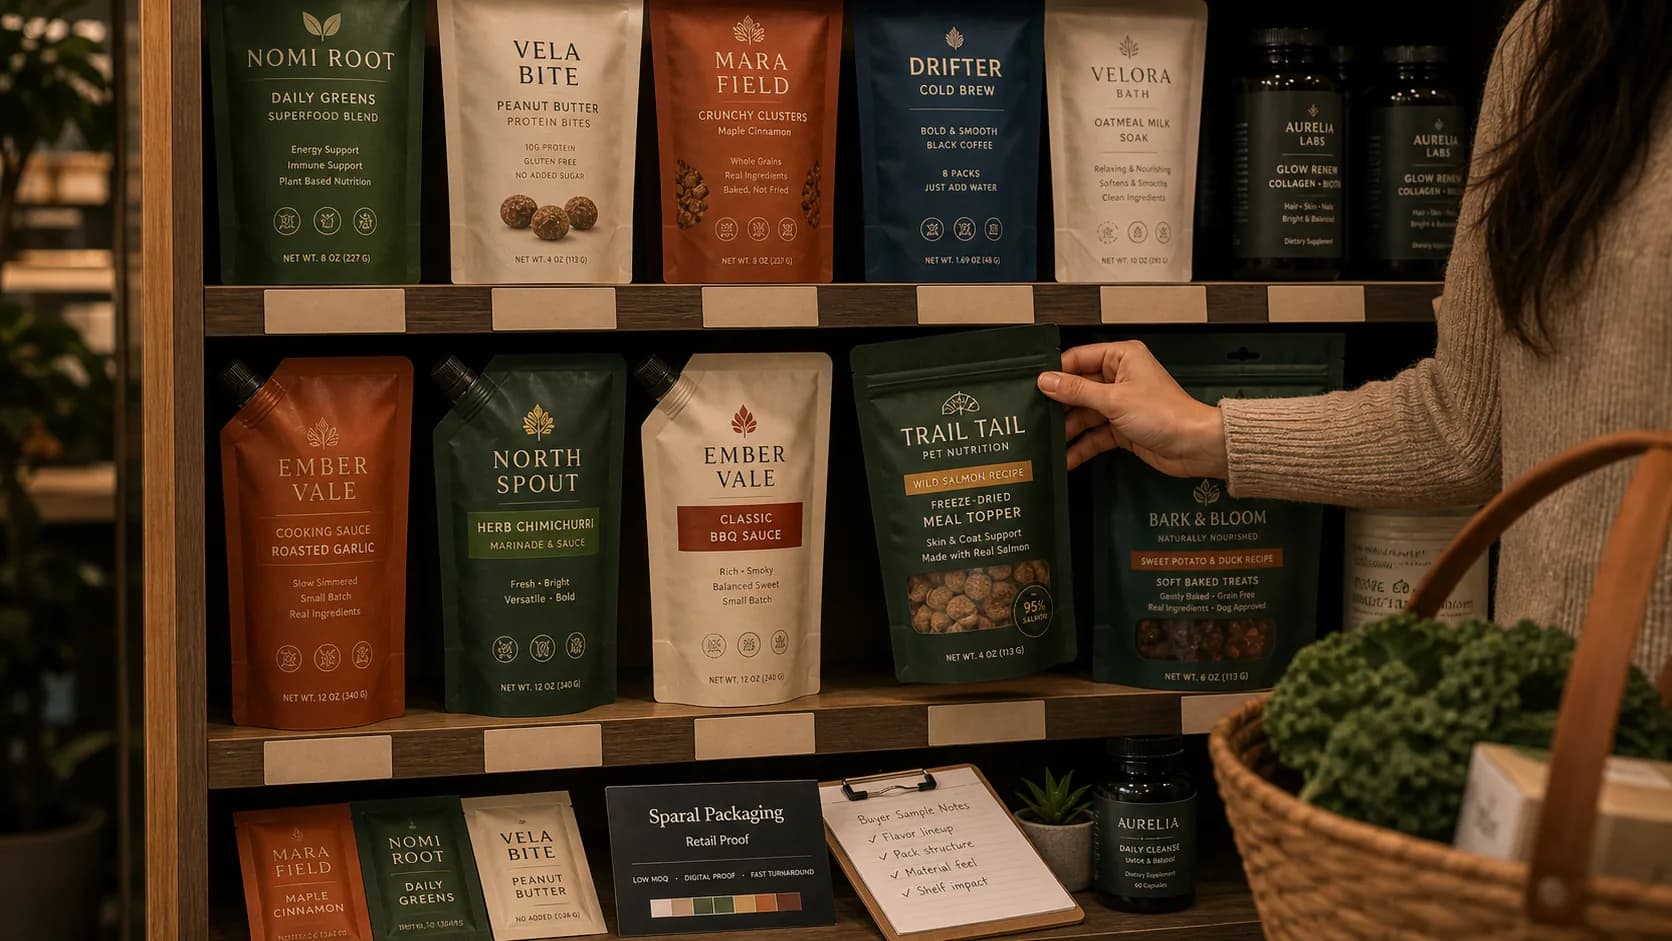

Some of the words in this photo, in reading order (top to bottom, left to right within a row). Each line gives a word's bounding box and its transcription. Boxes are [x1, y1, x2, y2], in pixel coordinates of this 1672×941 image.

[513, 40, 581, 61] VELA
[247, 48, 316, 68] NOMI
[329, 49, 395, 70] ROOT
[715, 51, 788, 70] MARA
[909, 57, 1002, 77] DRIFTER
[520, 65, 579, 86] BITE
[1091, 66, 1171, 84] VELORA
[717, 76, 789, 94] FIELD
[920, 85, 954, 95] COLD
[960, 85, 995, 96] BREW
[271, 92, 314, 104] DAILY
[320, 93, 376, 105] GREENS
[1117, 89, 1150, 99] BATH
[497, 101, 548, 112] PEANUT
[553, 102, 599, 114] BUTTER
[268, 111, 339, 121] SUPERFOOD
[344, 112, 378, 122] BLEND
[507, 117, 557, 127] PROTEIN
[562, 118, 591, 128] BITES
[699, 111, 753, 120] CRUNCHY
[758, 111, 808, 122] CLUSTERS
[1095, 118, 1144, 127] OATMEAL
[1148, 118, 1170, 128] MILK
[718, 127, 745, 137] Maple
[748, 127, 791, 136] Cinnamon
[921, 127, 946, 135] BOLD
[959, 127, 998, 135] SMOOTH
[1285, 122, 1334, 133] AURELIA
[1120, 133, 1148, 143] SOAK
[1300, 137, 1325, 146] LABS
[291, 145, 323, 156] Energy
[325, 145, 359, 156] Support
[927, 141, 957, 149] BLACK
[960, 141, 993, 149] COFFEE
[287, 161, 325, 170] Immune
[327, 161, 363, 172] Support
[558, 158, 576, 166] FREE
[1277, 165, 1308, 174] GLOW
[1311, 165, 1337, 174] RENEW
[279, 176, 302, 186] Plant
[305, 177, 331, 186] Based
[334, 177, 371, 186] Nutrition
[1269, 180, 1316, 188] COLLAGEN
[925, 184, 945, 192] JUST
[948, 184, 967, 192] ADD
[970, 184, 997, 192] WATER
[901, 422, 968, 447] TRAIL
[974, 416, 1026, 438] TAIL
[704, 446, 785, 465] EMBER
[922, 450, 942, 460] PET
[947, 442, 1009, 458] NUTRITION
[493, 448, 581, 469] NORTH
[279, 456, 368, 477] EMBER
[497, 473, 579, 494] SPOUT
[717, 470, 776, 488] VALE
[913, 478, 939, 488] WILD
[942, 472, 985, 485] SALMON
[989, 468, 1024, 480] RECIPE
[292, 482, 357, 502] VALE
[931, 492, 1011, 510] FREEZE-DRIED
[720, 513, 773, 525] CLASSIC
[923, 515, 962, 528] MEAL
[967, 506, 1021, 524] TOPPER
[1150, 512, 1190, 527] BARK
[1195, 512, 1206, 526] &
[1211, 510, 1267, 526] BLOOM
[276, 526, 332, 538] COOKING
[336, 524, 371, 536] SAUCE
[477, 522, 512, 533] HERB
[516, 519, 594, 532] CHIMICHURRI
[710, 532, 737, 543] BBQ
[743, 529, 781, 541] SAUCE
[926, 537, 946, 547] Skin
[949, 536, 956, 545] &
[959, 533, 982, 544] Coat
[985, 529, 1022, 543] Support
[1158, 534, 1207, 543] NATURALLY
[1210, 533, 1258, 542] NOURISHED
[272, 545, 329, 557] ROASTED
[334, 542, 375, 555] GARLIC
[490, 540, 544, 550] MARINADE
[548, 540, 553, 549] &
[557, 538, 585, 548] SAUCE
[922, 553, 947, 562] Made
[950, 550, 970, 559] with
[974, 547, 994, 557] Real
[997, 542, 1030, 555] Salmon
[1141, 557, 1168, 565] SWEET
[1172, 556, 1207, 565] POTATO
[1219, 556, 1243, 564] DUCK
[1246, 555, 1273, 563] RECIPE
[720, 567, 738, 576] Rich
[747, 566, 773, 576] Smoky
[293, 578, 314, 587] Slow
[316, 576, 358, 587] Simmered
[511, 579, 535, 589] Fresh
[544, 578, 570, 588] Bright
[713, 581, 753, 591] Balanced
[755, 581, 779, 590] Sweet
[1156, 578, 1181, 586] SOFT
[1185, 577, 1219, 586] BAKED
[1223, 576, 1259, 585] TREATS
[301, 593, 325, 603] Small
[328, 592, 352, 602] Batch
[504, 594, 545, 604] Versatile
[556, 593, 575, 602] Bold
[722, 596, 747, 606] Small
[749, 595, 773, 605] Batch
[1023, 599, 1046, 613] 95%
[290, 609, 309, 619] Real
[312, 607, 361, 620] Ingredients
[649, 807, 700, 828] Sparal
[704, 805, 784, 824] Packaging
[858, 814, 890, 826] Buyer
[896, 807, 935, 820] Sample
[938, 802, 970, 812] Notes
[1118, 817, 1179, 830] AURELIA
[500, 831, 552, 844] VELA
[686, 836, 717, 847] Retail
[720, 833, 750, 845] Proof
[882, 831, 916, 842] Flavor
[920, 825, 953, 836] lineup
[389, 835, 441, 849] NOMI
[1120, 845, 1144, 853] DAILY
[1146, 843, 1180, 853] CLEANSE
[273, 846, 329, 862] MARA
[508, 846, 555, 861] BITE
[893, 849, 920, 860] Pack
[924, 841, 974, 855] structure
[392, 851, 443, 865] ROOT
[276, 862, 332, 877] FIELD
[905, 862, 951, 877] Material
[955, 858, 977, 869] feel
[512, 874, 563, 886] PEANUT
[633, 876, 649, 884] LOW
[651, 875, 669, 883] MOQ
[713, 872, 735, 880] PROOF
[768, 869, 814, 877] TURNAROUND
[405, 880, 443, 892] DAILY
[917, 884, 946, 896] Shelf
[951, 877, 989, 892] impact
[285, 891, 328, 903] MAPLE
[399, 893, 455, 905] GREENS
[516, 887, 567, 899] BUTTER
[274, 904, 344, 918] CINNAMON
